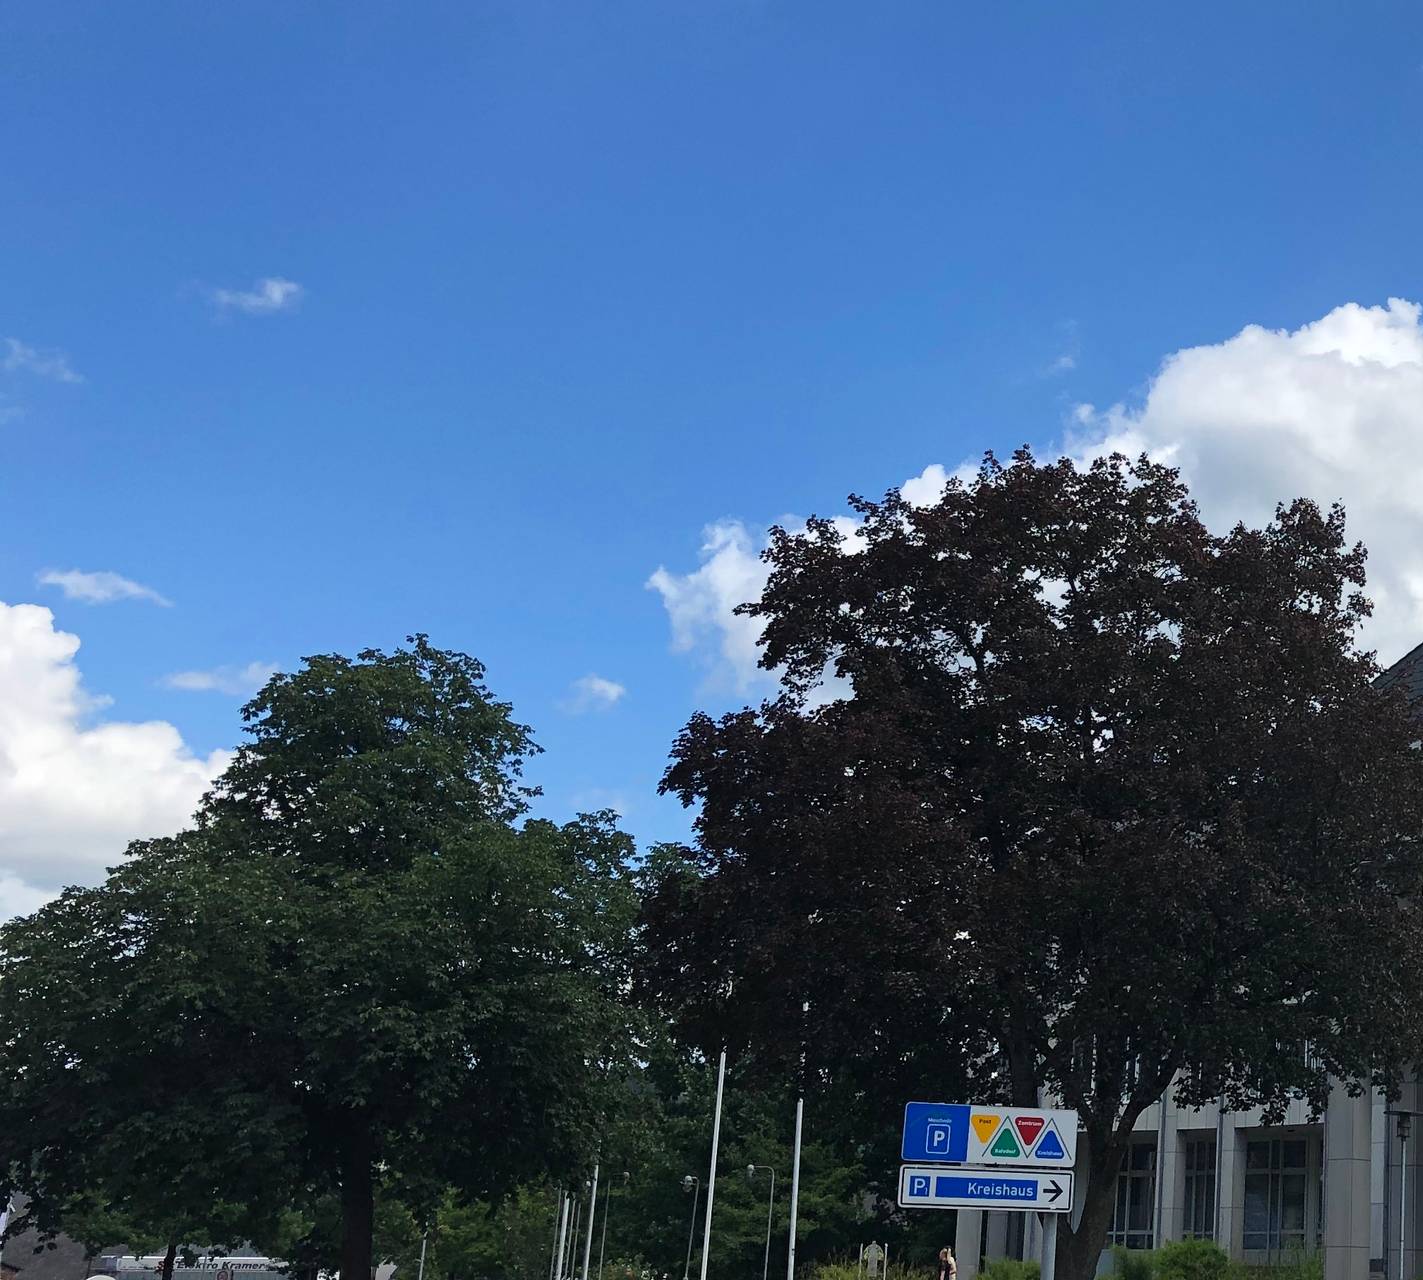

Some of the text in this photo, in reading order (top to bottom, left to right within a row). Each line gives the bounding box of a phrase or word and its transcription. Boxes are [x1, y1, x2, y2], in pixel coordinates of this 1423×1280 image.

[933, 1130, 946, 1147] P
[967, 1182, 1034, 1197] Kreishaus
[176, 1260, 219, 1269] Eekro
[221, 1261, 266, 1270] Kramer
